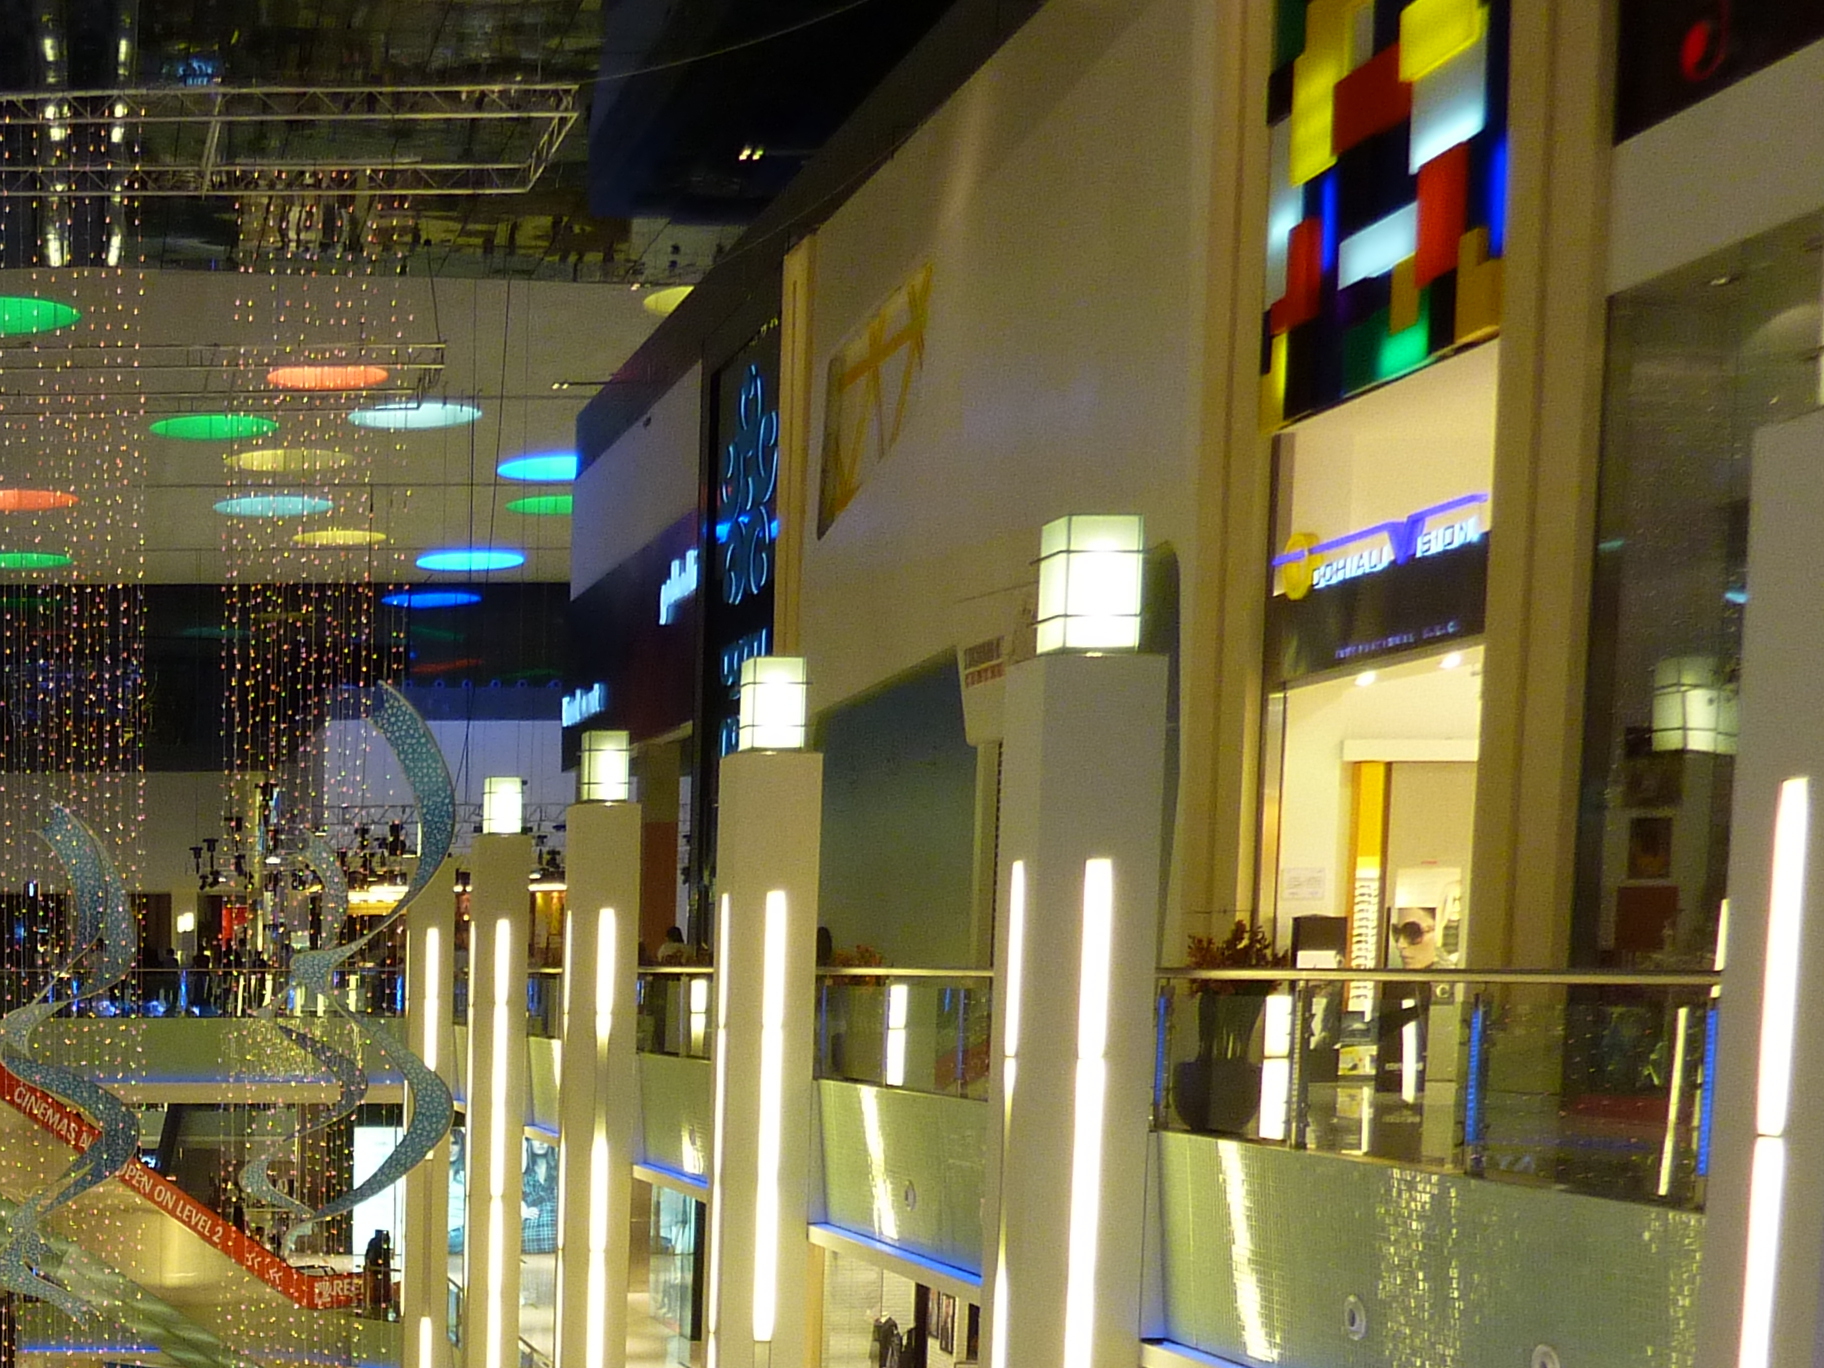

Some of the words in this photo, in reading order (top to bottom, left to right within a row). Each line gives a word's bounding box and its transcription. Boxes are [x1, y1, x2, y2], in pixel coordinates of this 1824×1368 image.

[1386, 515, 1482, 566] VISION
[14, 1086, 79, 1144] CINEMAS
[154, 1185, 177, 1212] ON
[175, 1202, 212, 1238] LEVEL
[211, 1226, 224, 1244] 2
